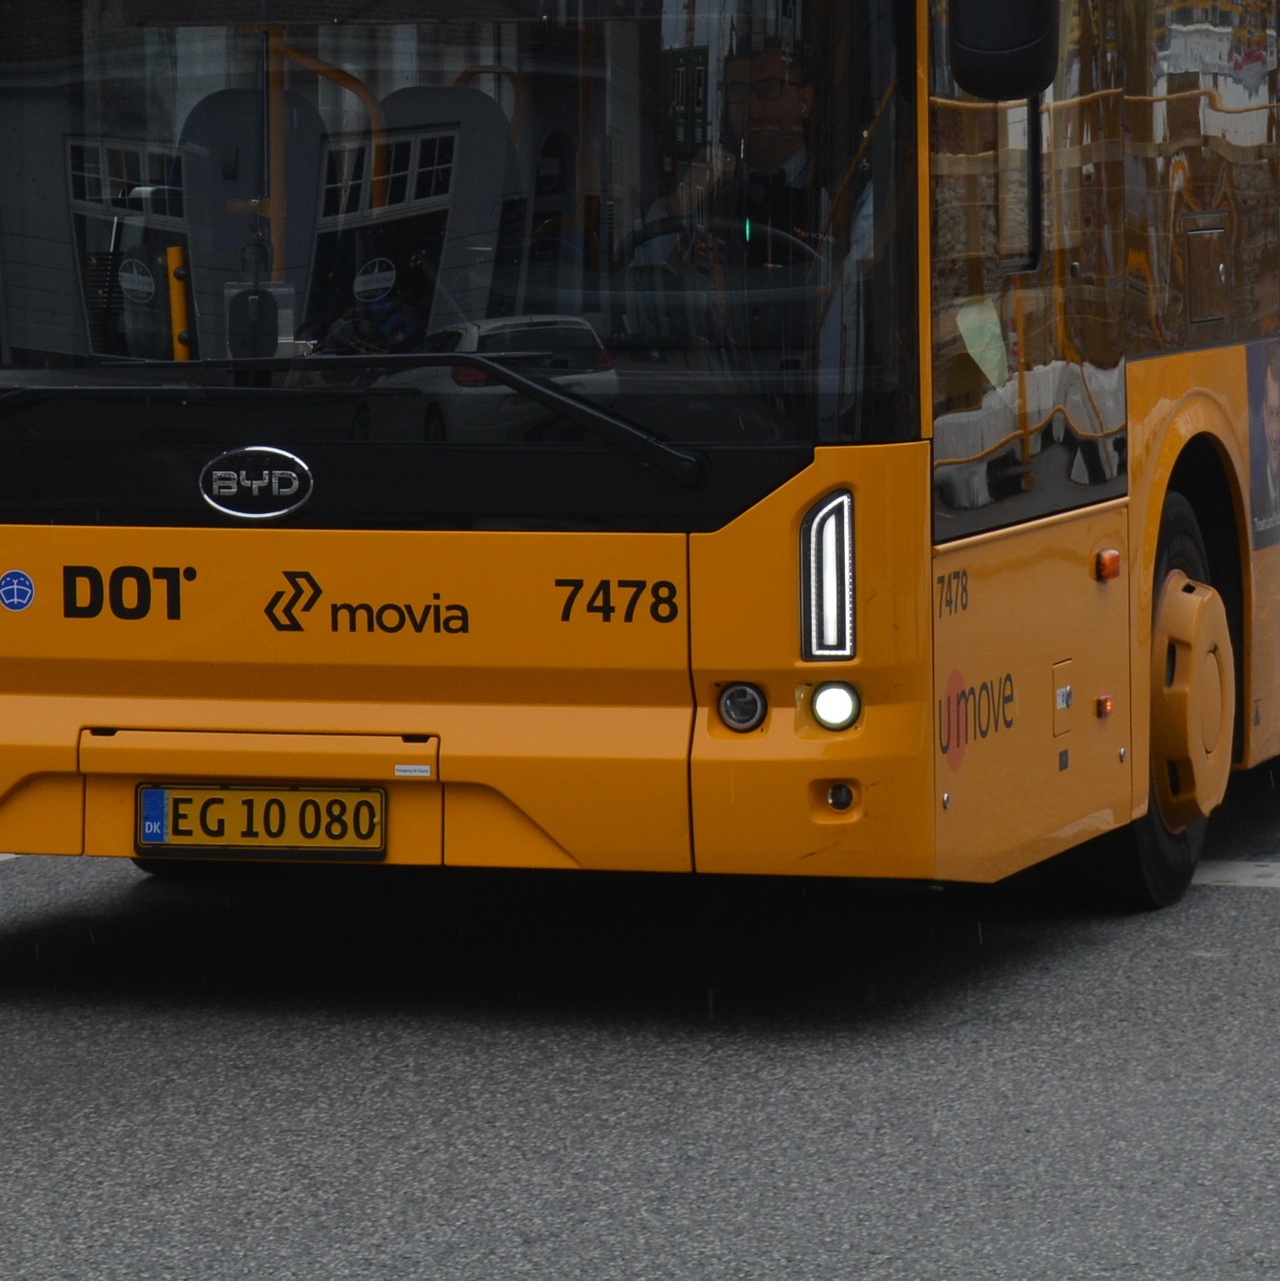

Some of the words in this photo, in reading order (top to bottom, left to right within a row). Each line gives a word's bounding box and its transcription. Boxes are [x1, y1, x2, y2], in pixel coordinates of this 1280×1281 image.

[212, 470, 299, 496] BYD
[63, 565, 183, 620] DOT
[330, 592, 470, 634] movia
[554, 578, 679, 624] 7478
[936, 569, 968, 618] 7478
[939, 673, 1014, 754] umove
[145, 821, 161, 834] DK
[171, 797, 225, 837] EG
[240, 797, 287, 838] 10
[298, 798, 377, 840] 080
